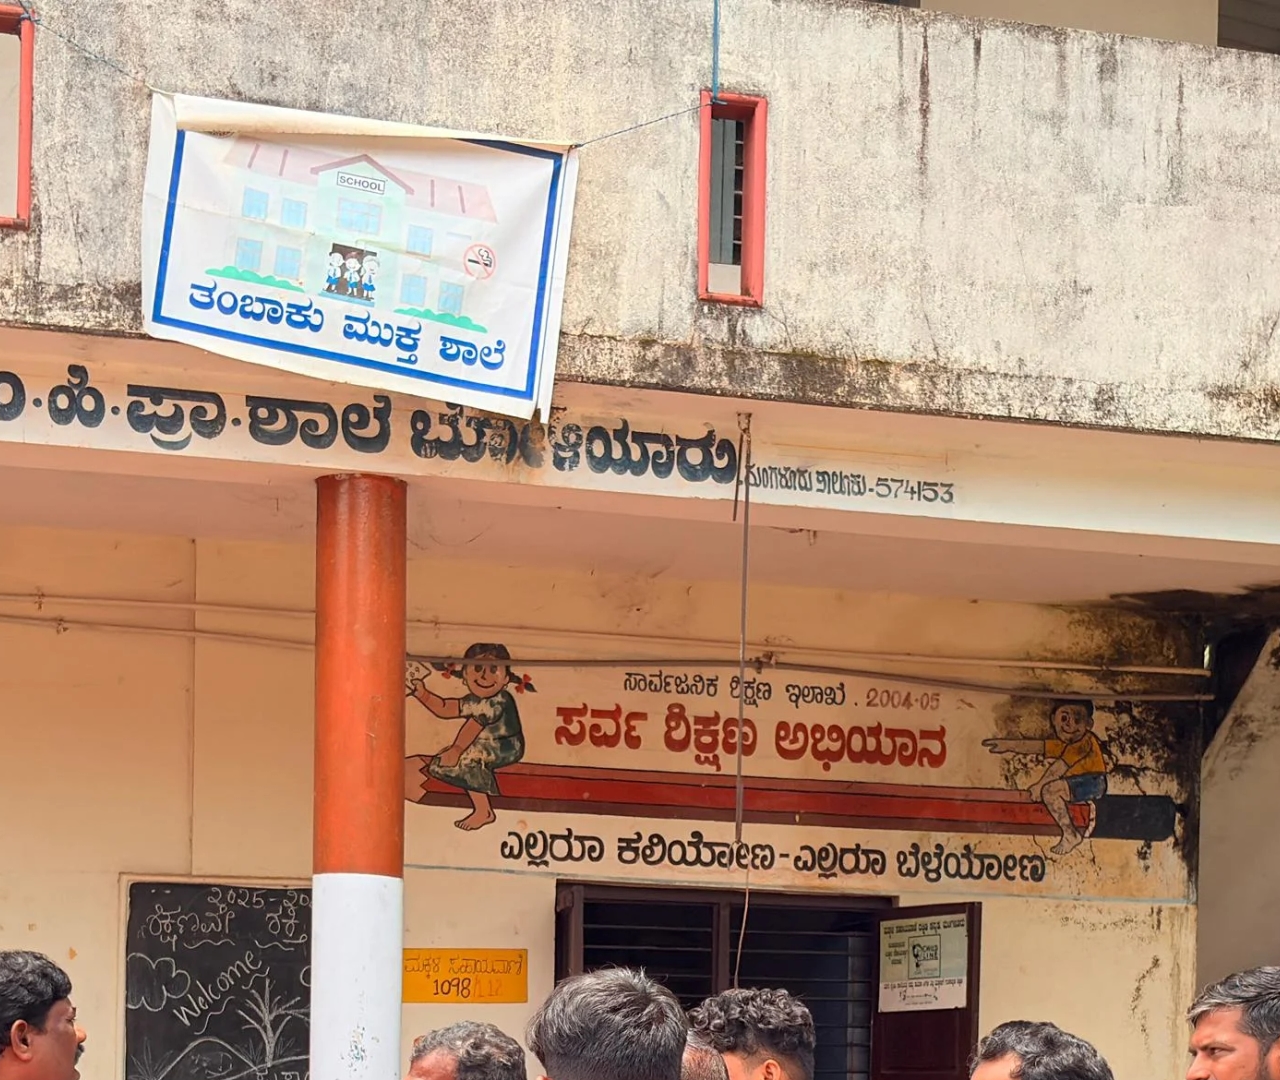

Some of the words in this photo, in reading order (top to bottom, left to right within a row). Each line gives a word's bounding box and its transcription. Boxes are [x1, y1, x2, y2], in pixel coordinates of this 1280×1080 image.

[339, 175, 384, 192] SCHOOL
[189, 279, 324, 332] ತಂಬಾಕು
[343, 311, 421, 365] ಮುಕ್ತ
[439, 336, 506, 371] ಶಾಲೆ
[623, 670, 719, 698] ಸಾರ್ವಜನಿಕ
[554, 702, 648, 750] ಸರ್ವ
[663, 702, 758, 772] ಶಿಕ್ಷಣ
[774, 720, 947, 772] ಅಭಿಯಾನ
[500, 828, 605, 868] ಎಲ್ಲರೂ
[896, 844, 1046, 883] ಬೆಳೆಯೋಣ
[208, 887, 312, 908] 2025-20
[173, 951, 263, 1027] Welcome
